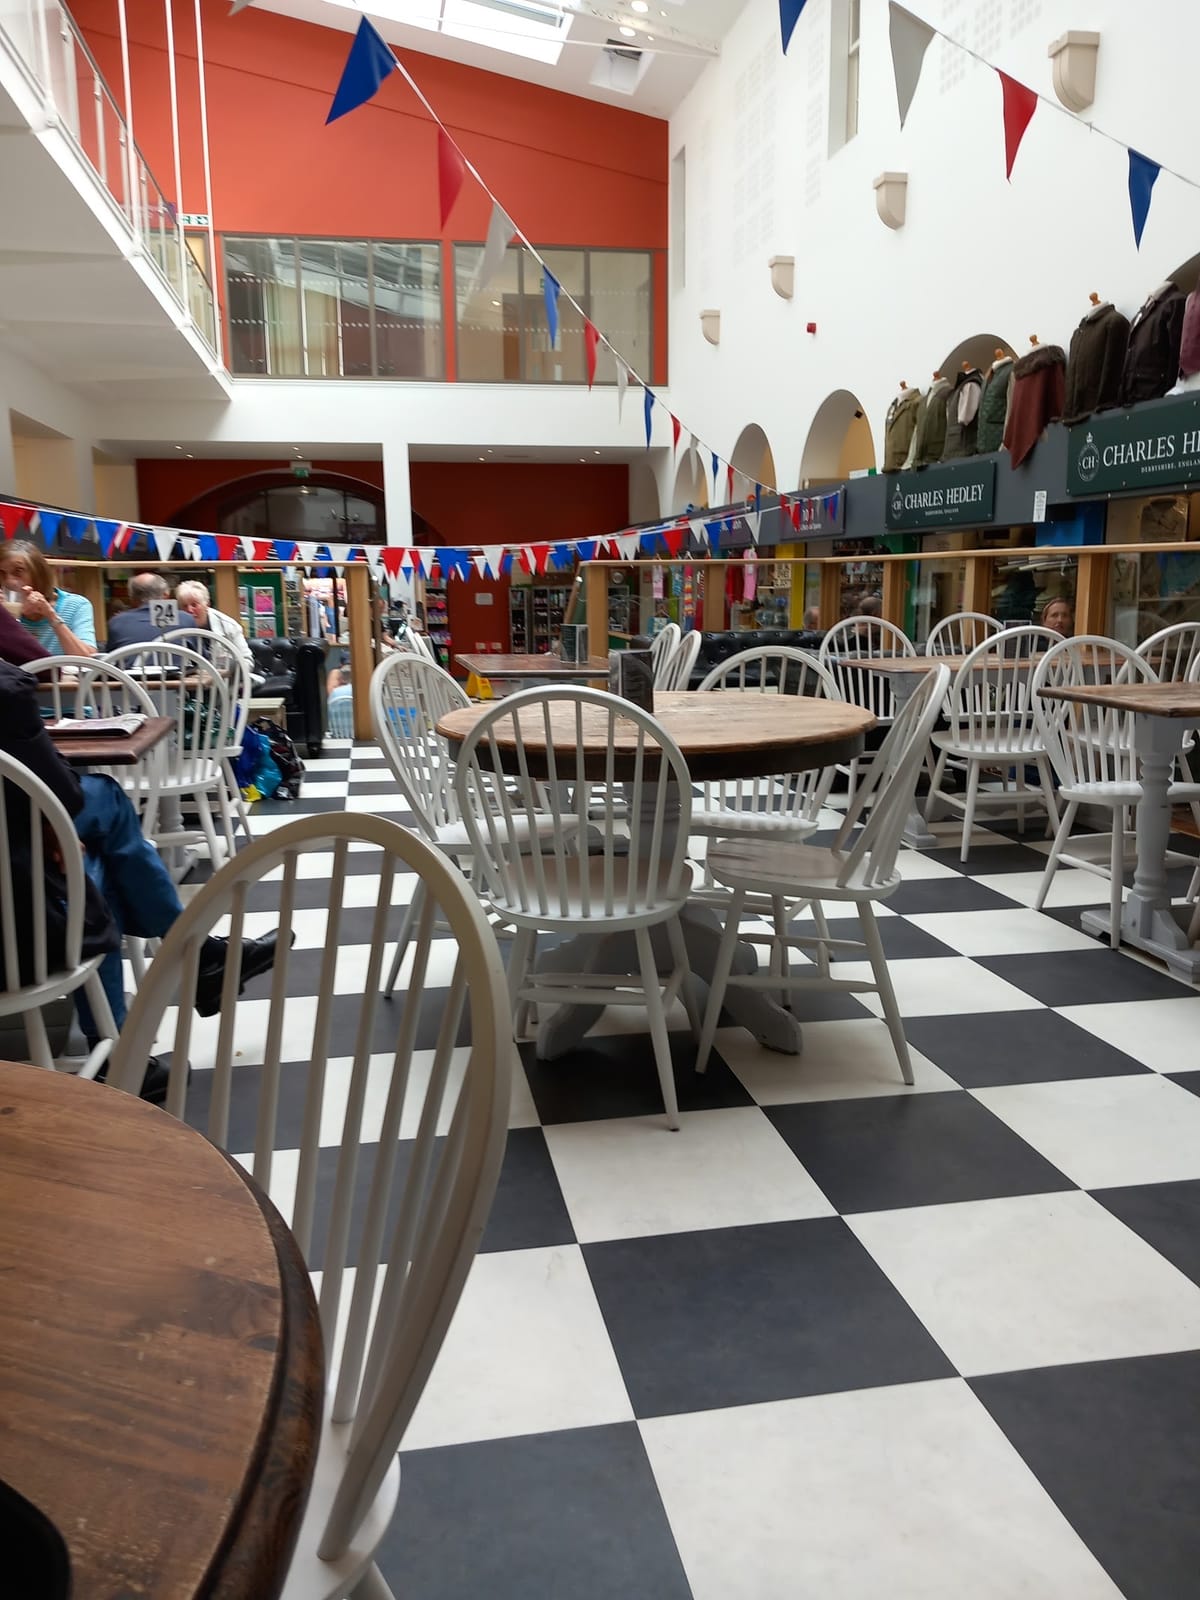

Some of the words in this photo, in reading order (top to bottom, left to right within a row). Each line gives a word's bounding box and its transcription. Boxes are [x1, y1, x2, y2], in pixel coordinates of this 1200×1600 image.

[1103, 435, 1175, 467] CHARLES
[1082, 456, 1095, 470] CH
[904, 490, 943, 510] CHARLES
[946, 484, 984, 505] HEDLEY
[154, 604, 175, 623] 24
